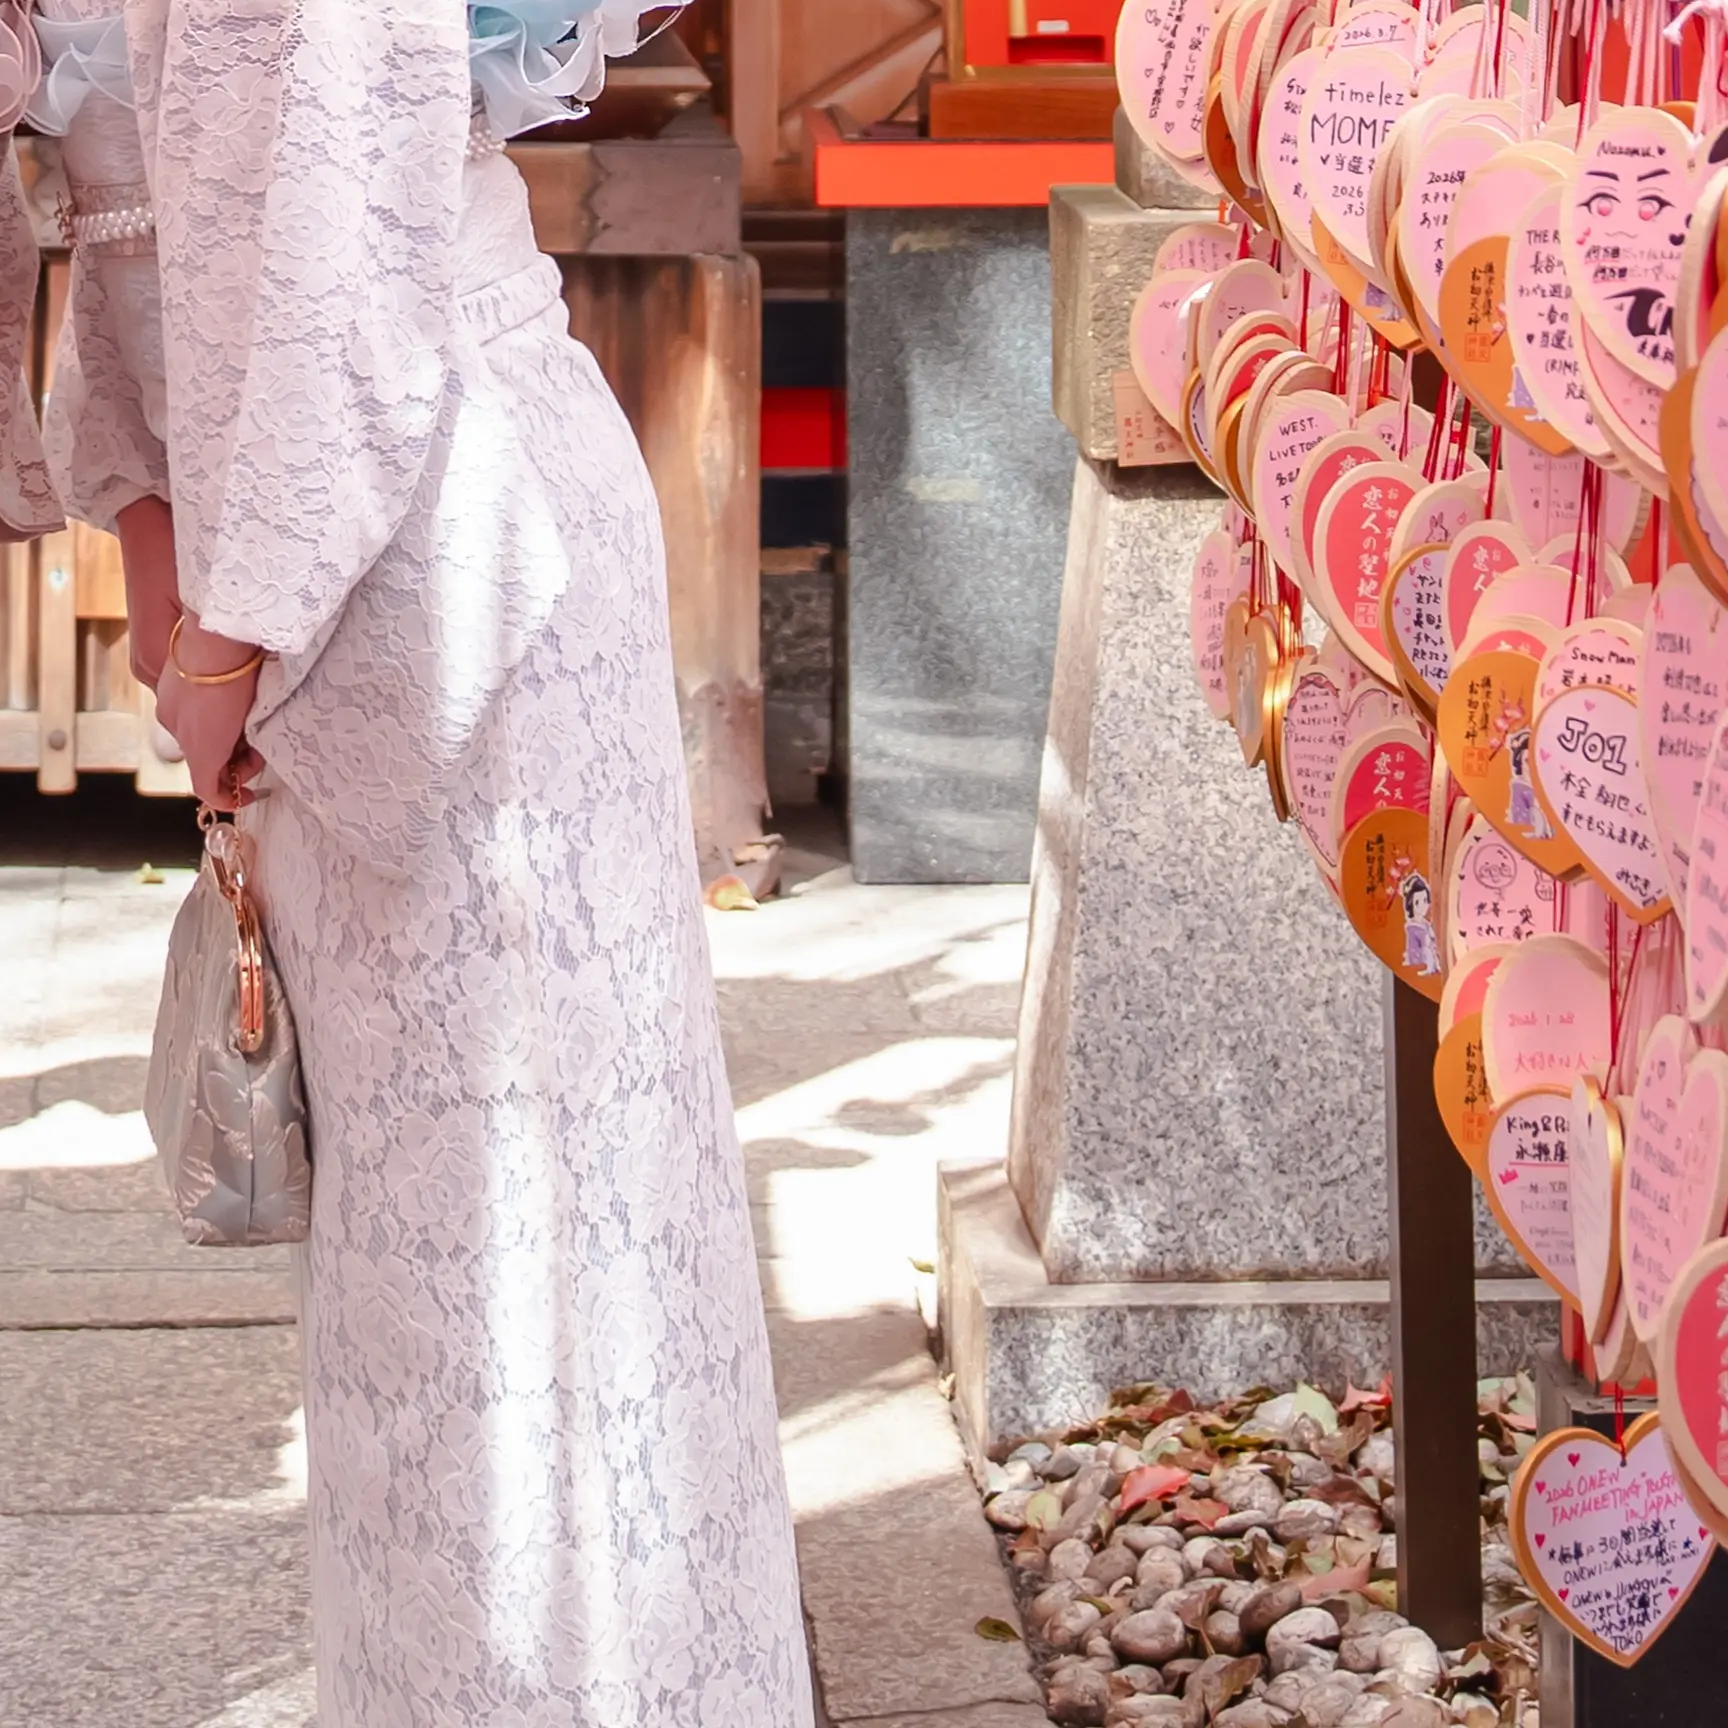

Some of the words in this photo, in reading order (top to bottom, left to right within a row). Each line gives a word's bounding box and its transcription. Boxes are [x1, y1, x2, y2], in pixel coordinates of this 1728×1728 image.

[1324, 80, 1405, 107] timelez
[1331, 184, 1365, 199] 2026
[1279, 416, 1319, 439] WEST.
[1269, 443, 1298, 462] LIVE
[1357, 485, 1382, 601] 恋人の聖地
[1576, 1468, 1621, 1496] ONEW
